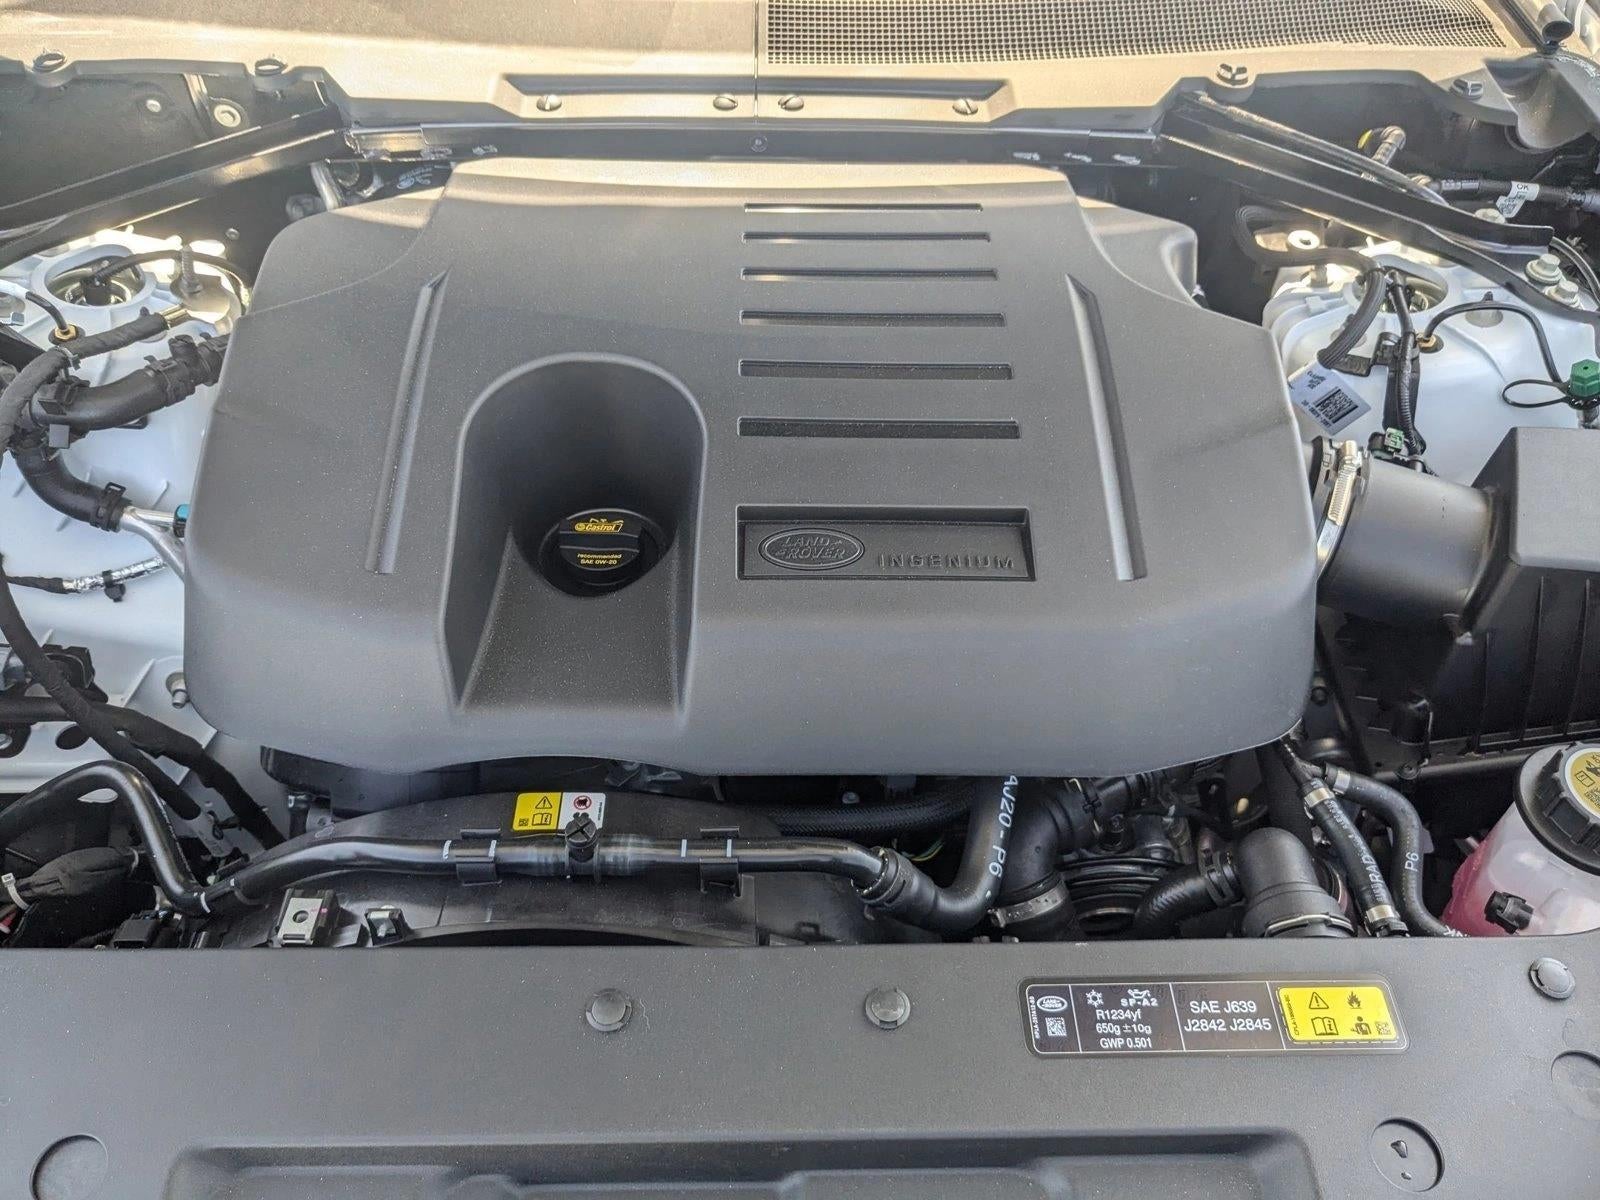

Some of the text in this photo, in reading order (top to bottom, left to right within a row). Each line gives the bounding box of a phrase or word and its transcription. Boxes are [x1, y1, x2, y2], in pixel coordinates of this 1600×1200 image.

[1516, 183, 1529, 191] OK
[585, 523, 616, 532] Castrol
[783, 536, 830, 547] LAND
[785, 547, 847, 559] ROVER
[878, 553, 1015, 569] INGENIUM
[1404, 851, 1419, 872] P6
[1120, 998, 1158, 1007] SP-A2
[1189, 1000, 1257, 1013] SAE J639
[1095, 1009, 1142, 1022] R1234yf
[1095, 1022, 1152, 1035] 650g ±10g
[1184, 1018, 1272, 1032] J2842 J2845
[1099, 1037, 1153, 1049] GWP 0.501
